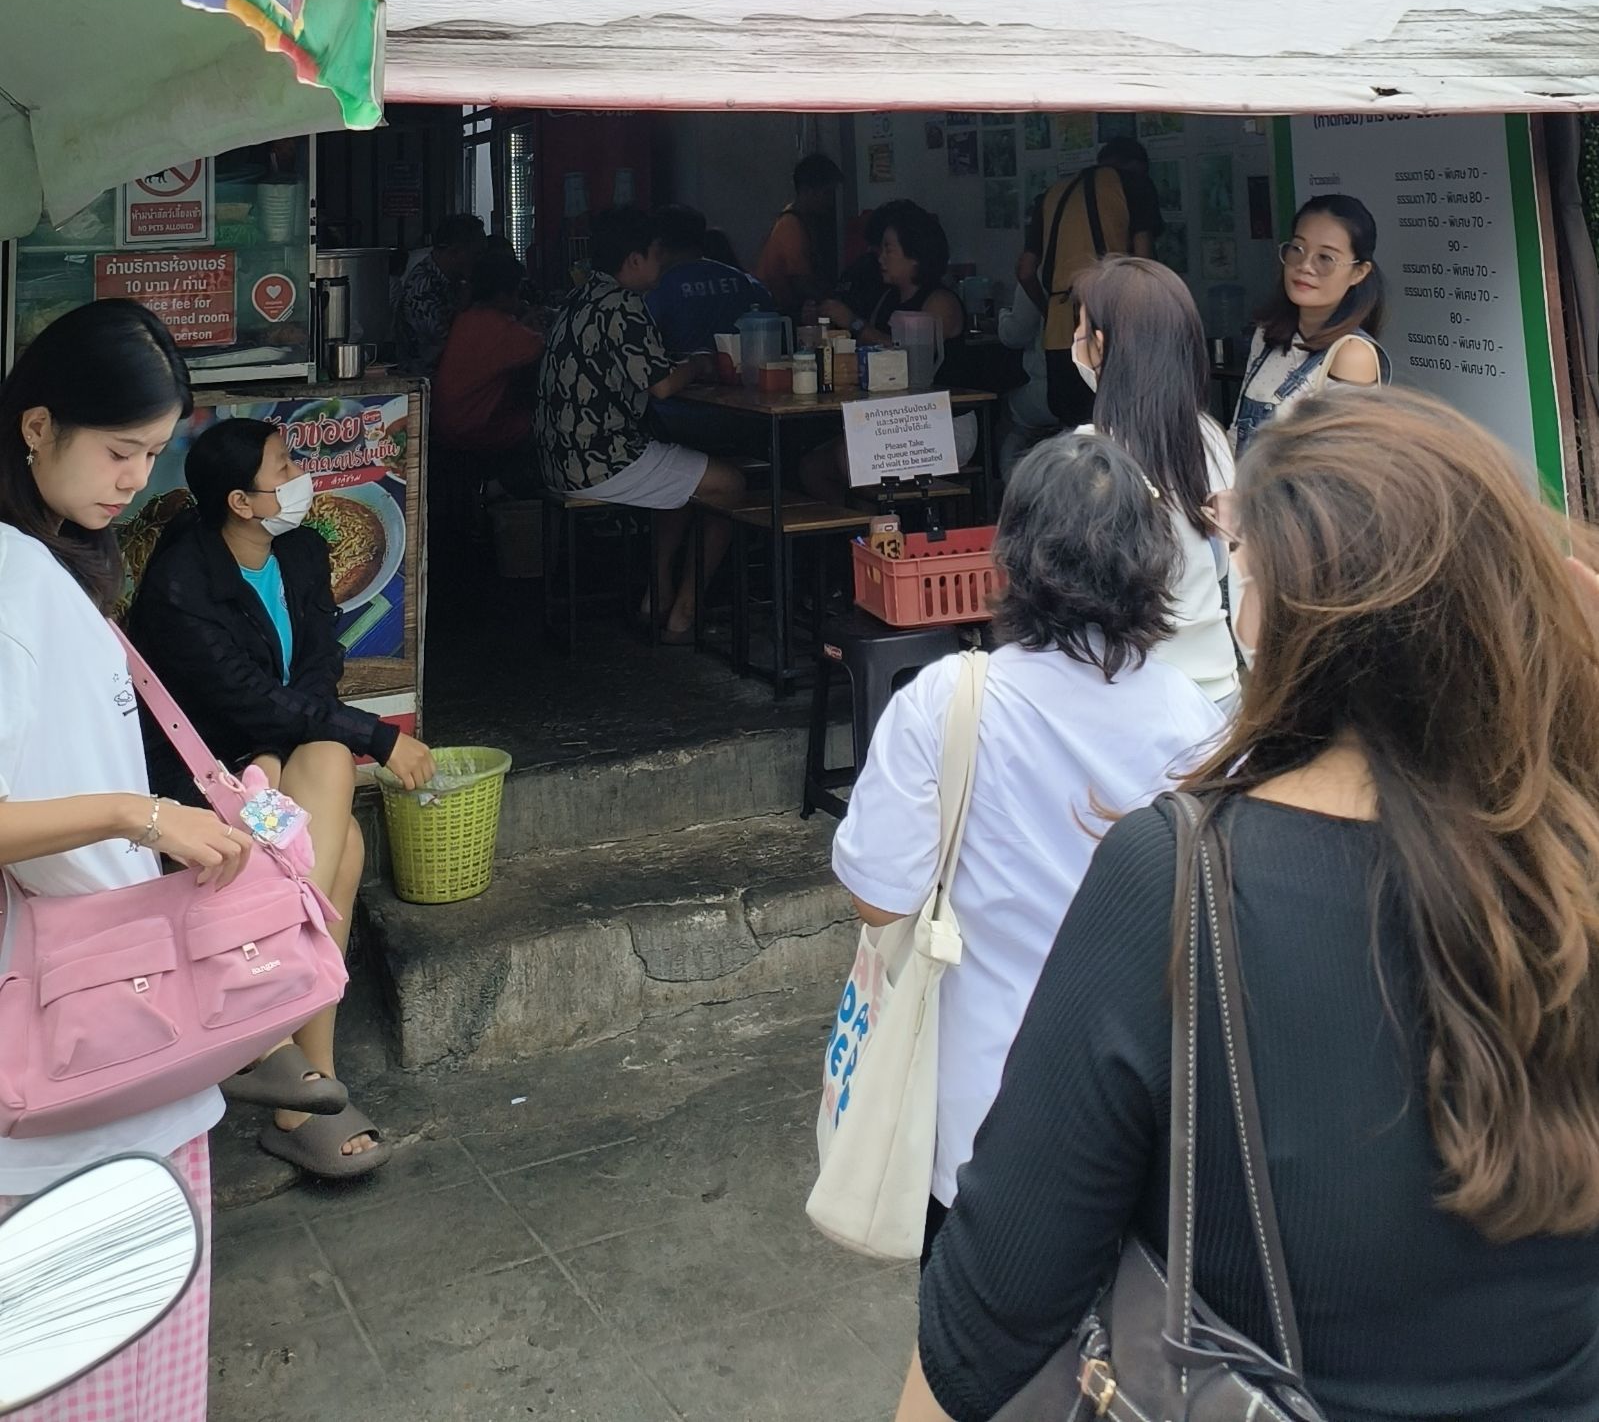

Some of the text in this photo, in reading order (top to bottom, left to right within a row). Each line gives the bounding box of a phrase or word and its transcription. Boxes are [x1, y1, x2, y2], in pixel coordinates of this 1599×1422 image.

[149, 224, 164, 232] PETS
[166, 223, 194, 231] ALLOWED
[106, 254, 226, 275] ค่าบริการห้องแอร์
[125, 277, 207, 293] 10 บาท / ท่าน
[172, 298, 190, 309] fee
[194, 297, 211, 309] for
[198, 313, 230, 324] room
[884, 439, 925, 451] Please Take
[871, 461, 885, 470] and
[885, 459, 901, 468] wait
[902, 458, 910, 466] to
[911, 457, 920, 465] be
[921, 453, 943, 463] seated
[873, 453, 886, 461] the
[886, 450, 909, 460] queue
